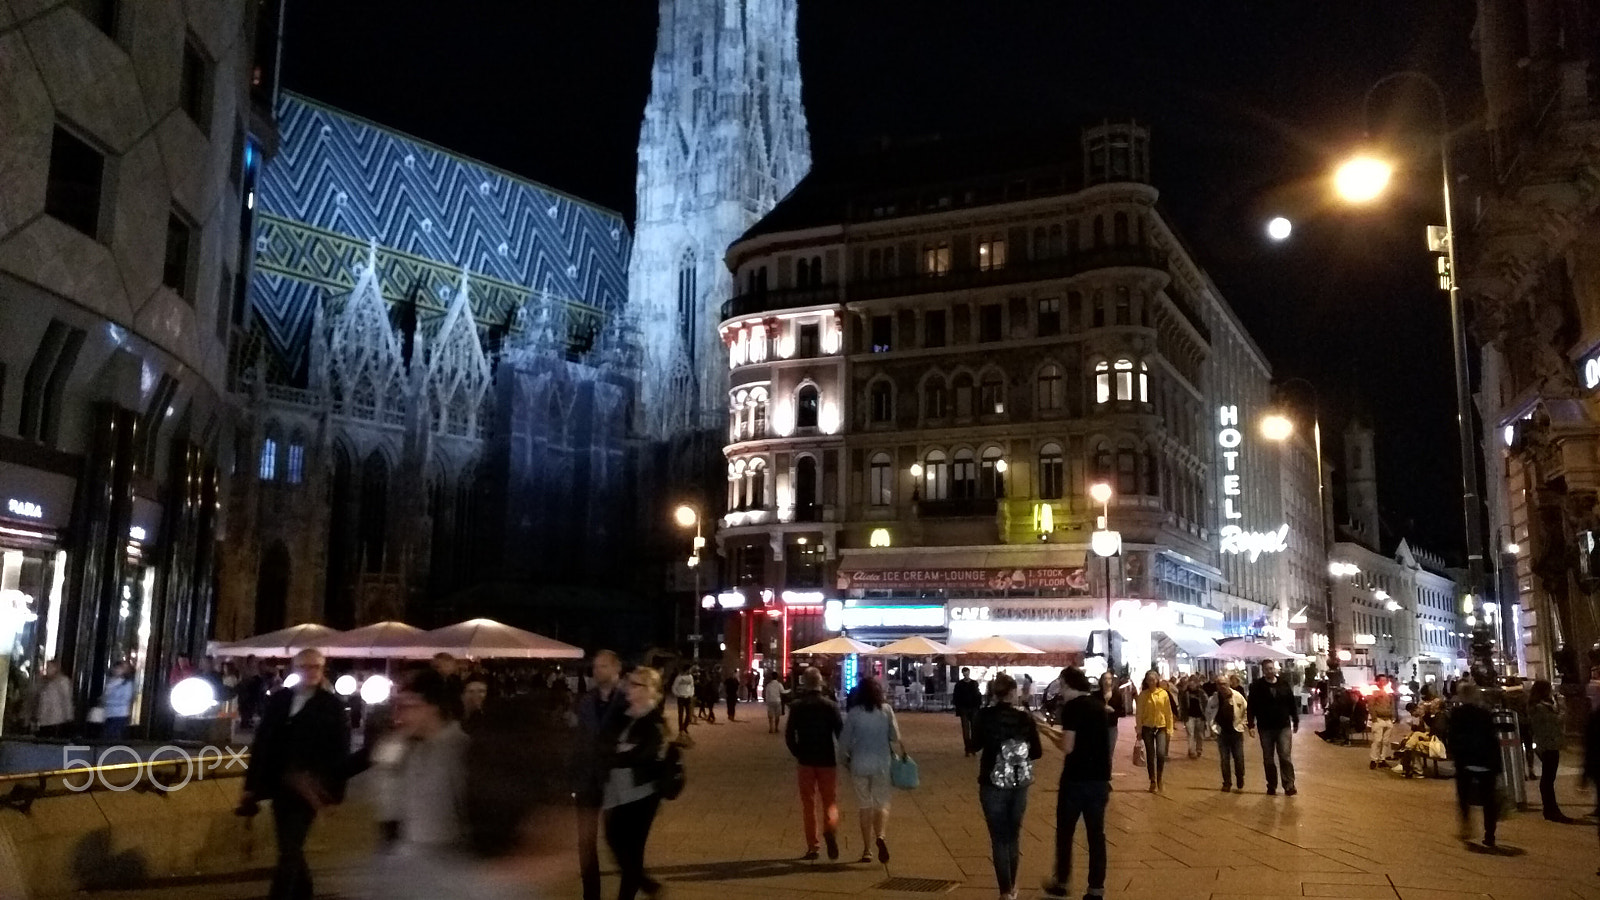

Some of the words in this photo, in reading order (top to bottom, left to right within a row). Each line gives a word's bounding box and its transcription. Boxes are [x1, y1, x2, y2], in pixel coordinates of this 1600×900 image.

[1218, 404, 1242, 519] HOTEL
[1220, 523, 1289, 564] Royal
[883, 571, 900, 580] ICE
[903, 570, 986, 581] CREAM-LOUNGE
[1037, 569, 1064, 577] STOCK
[1039, 578, 1066, 587] FLOOR
